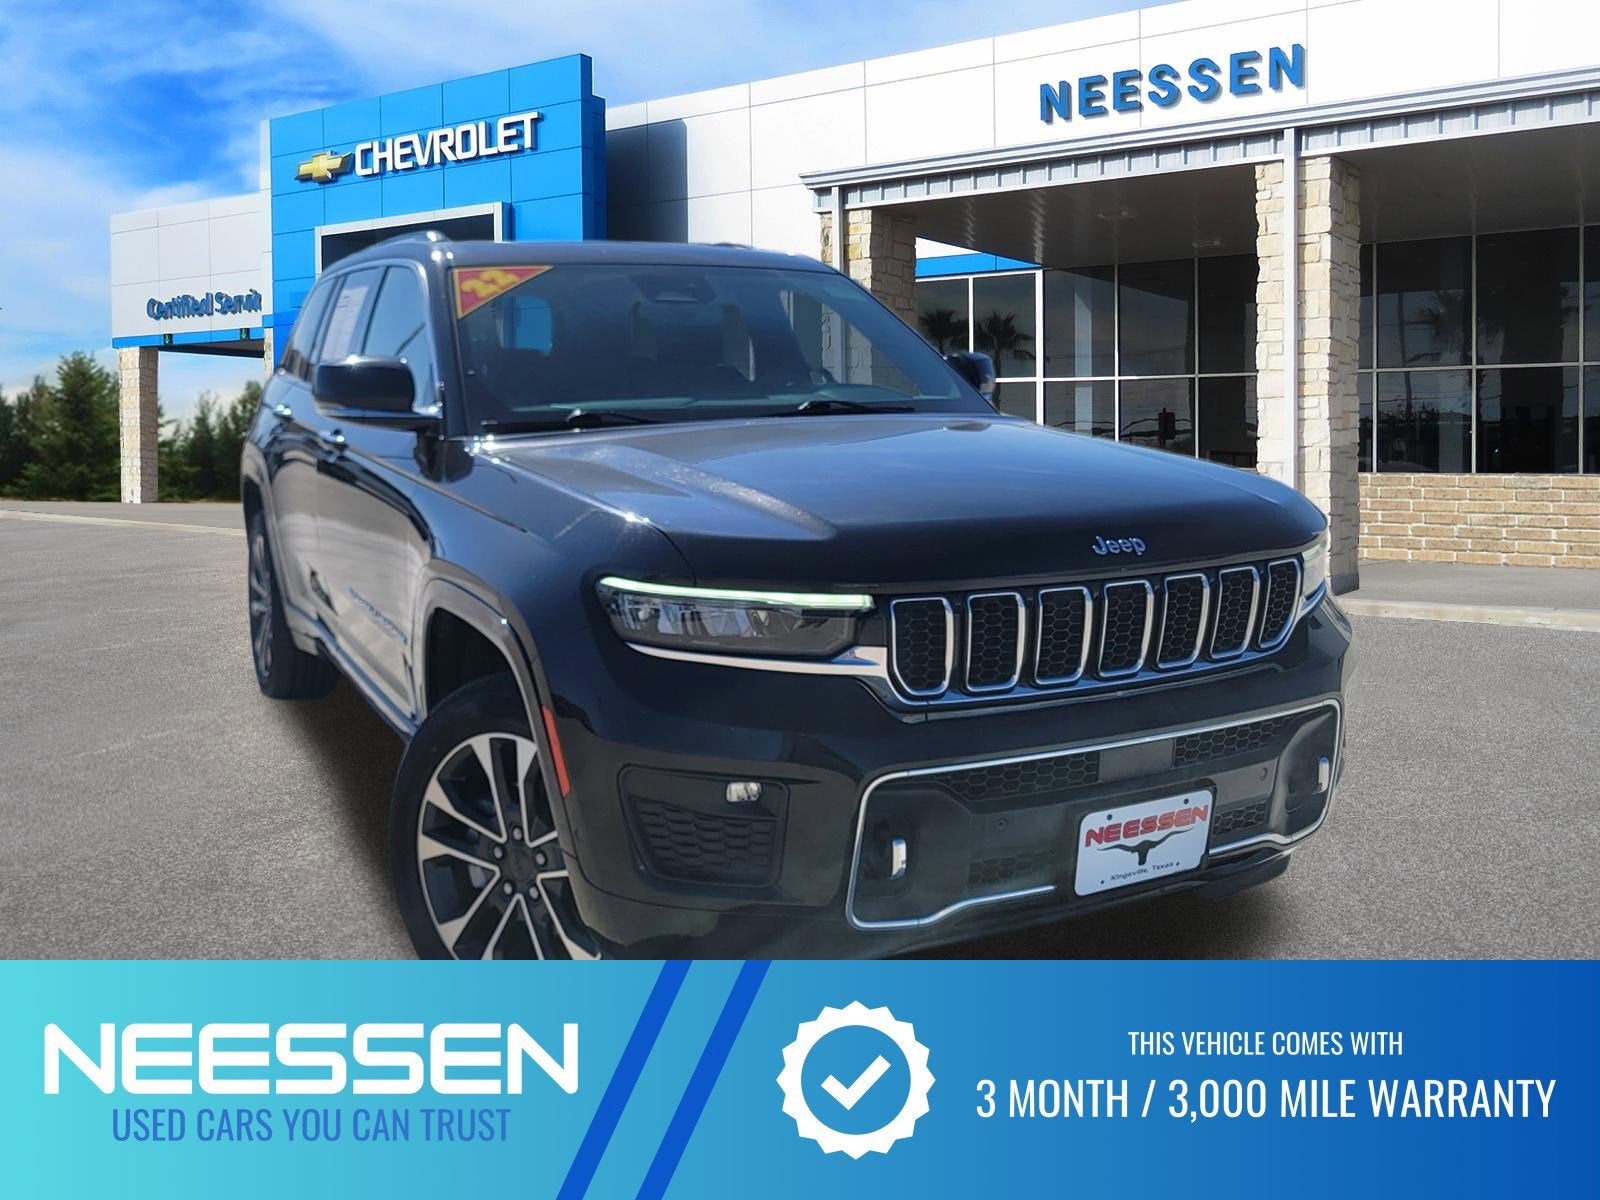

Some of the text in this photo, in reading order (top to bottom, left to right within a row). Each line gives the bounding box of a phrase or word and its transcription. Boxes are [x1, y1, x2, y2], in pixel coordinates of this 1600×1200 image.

[1040, 44, 1306, 123] NEESSEN
[354, 111, 542, 177] CHEVROLET
[147, 292, 214, 320] Certified
[1092, 535, 1146, 556] Jeep
[1085, 804, 1210, 848] NEESSEN
[1152, 861, 1174, 871] Texas
